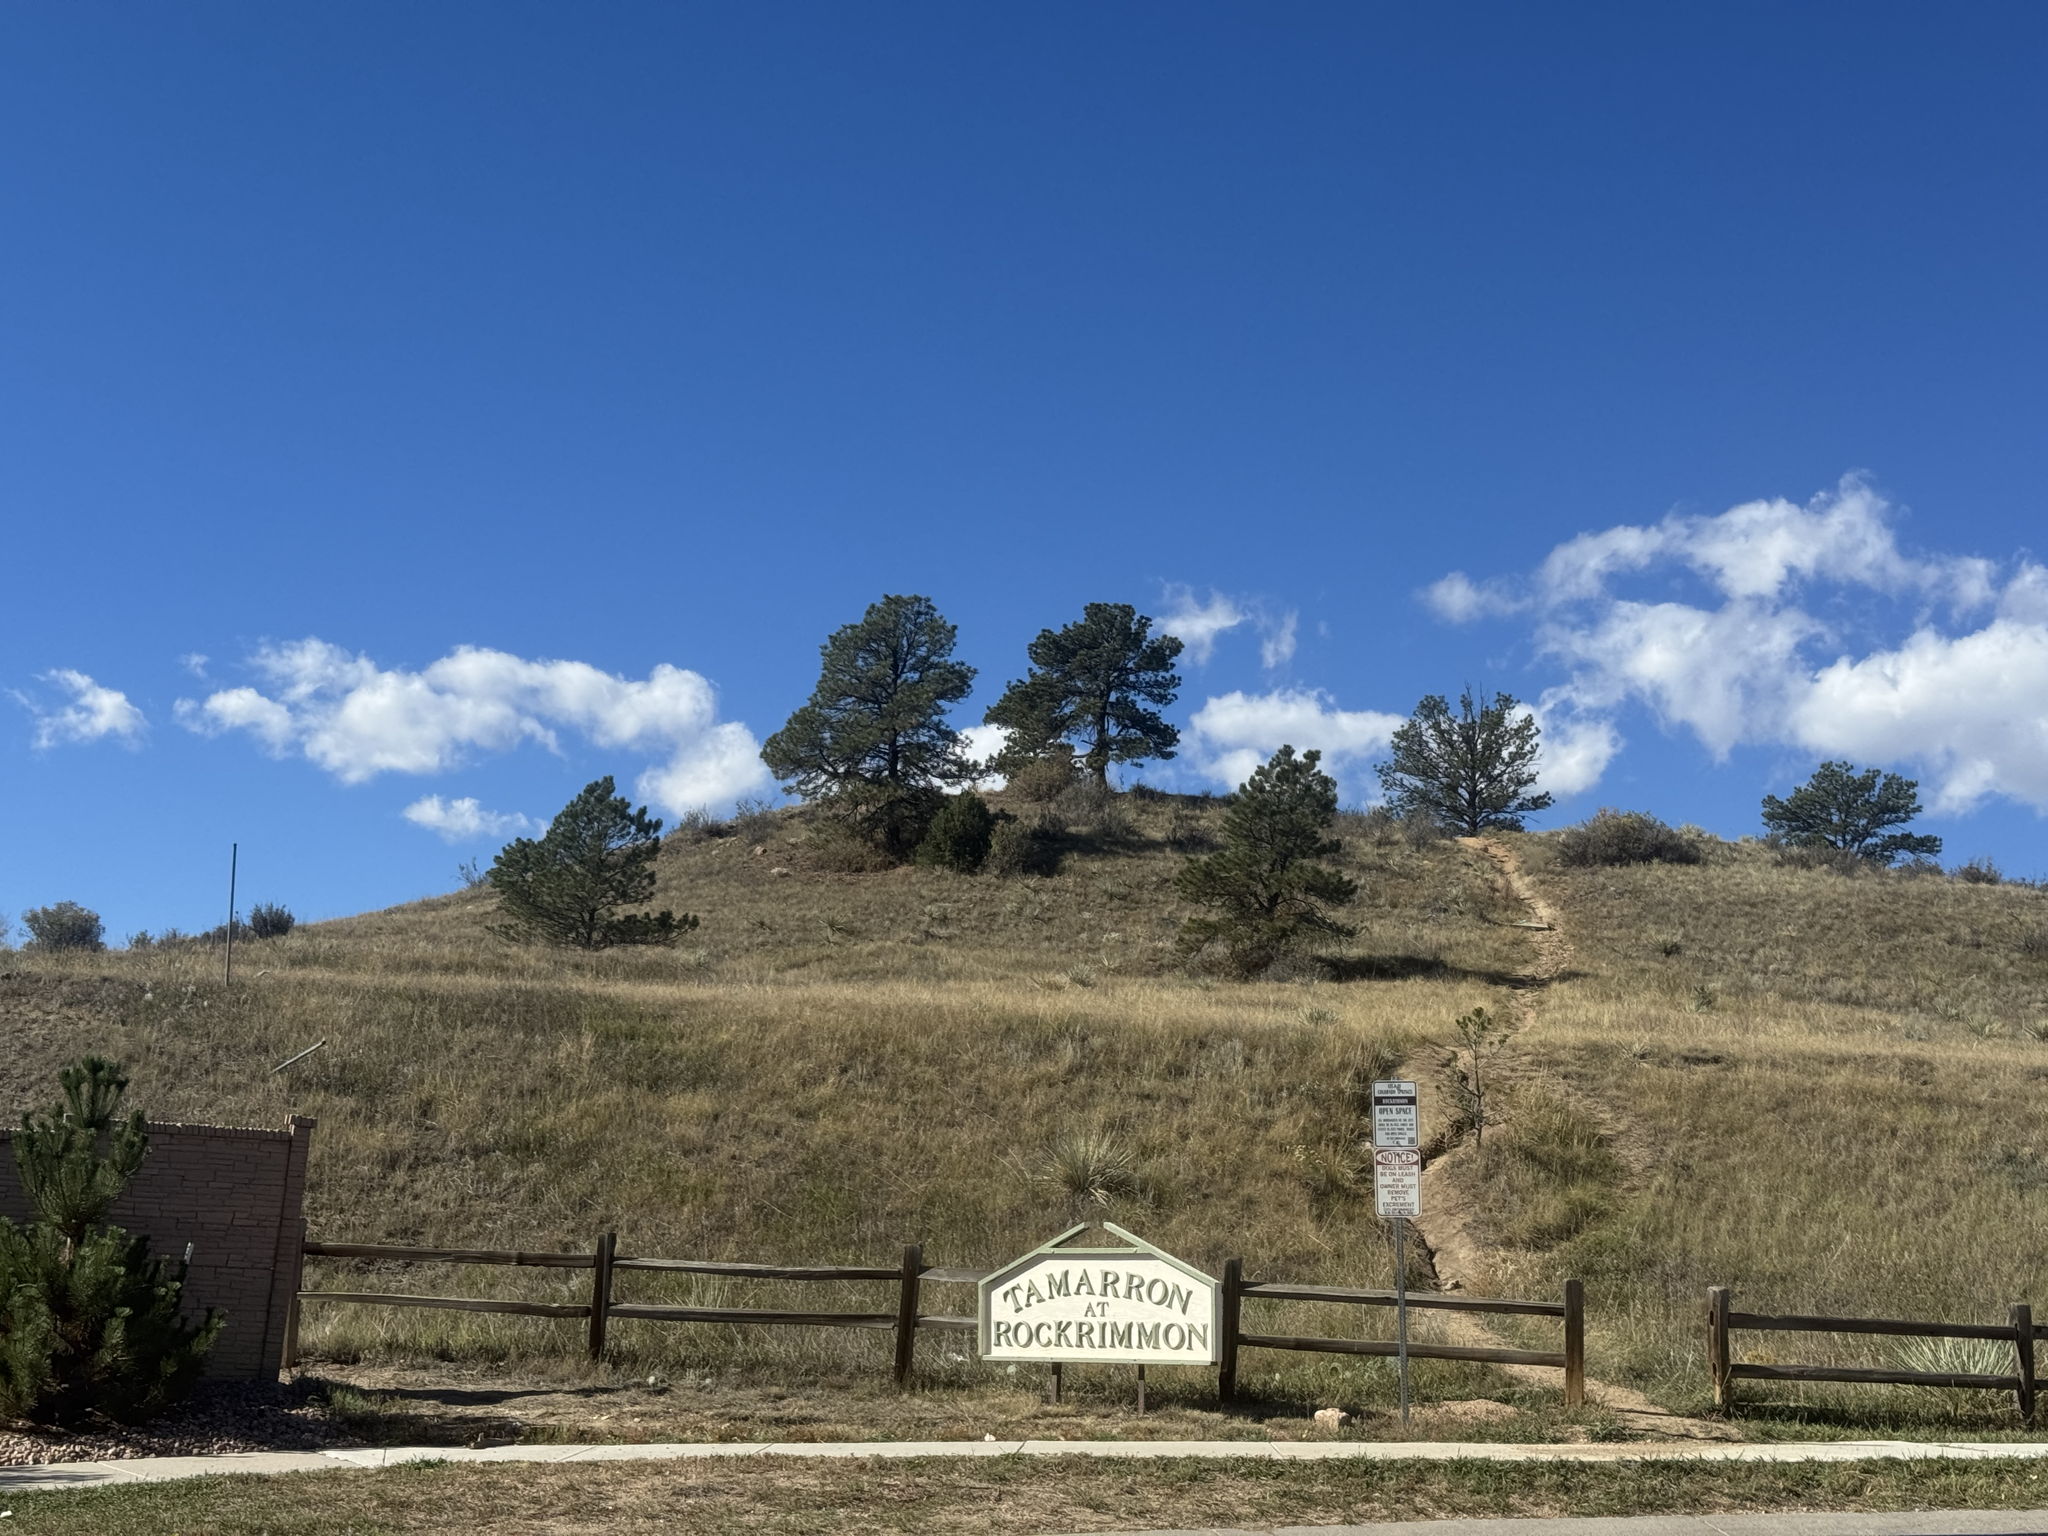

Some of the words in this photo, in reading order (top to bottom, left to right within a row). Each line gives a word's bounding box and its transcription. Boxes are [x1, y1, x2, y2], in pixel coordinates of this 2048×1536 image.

[1378, 1107, 1393, 1115] OPEN
[1395, 1107, 1412, 1115] SPACE
[1381, 1151, 1414, 1163] NOTICE!
[1002, 1268, 1193, 1316] TAMARRON
[1084, 1301, 1110, 1318] AT
[992, 1319, 1208, 1351] ROCKRIMMON
